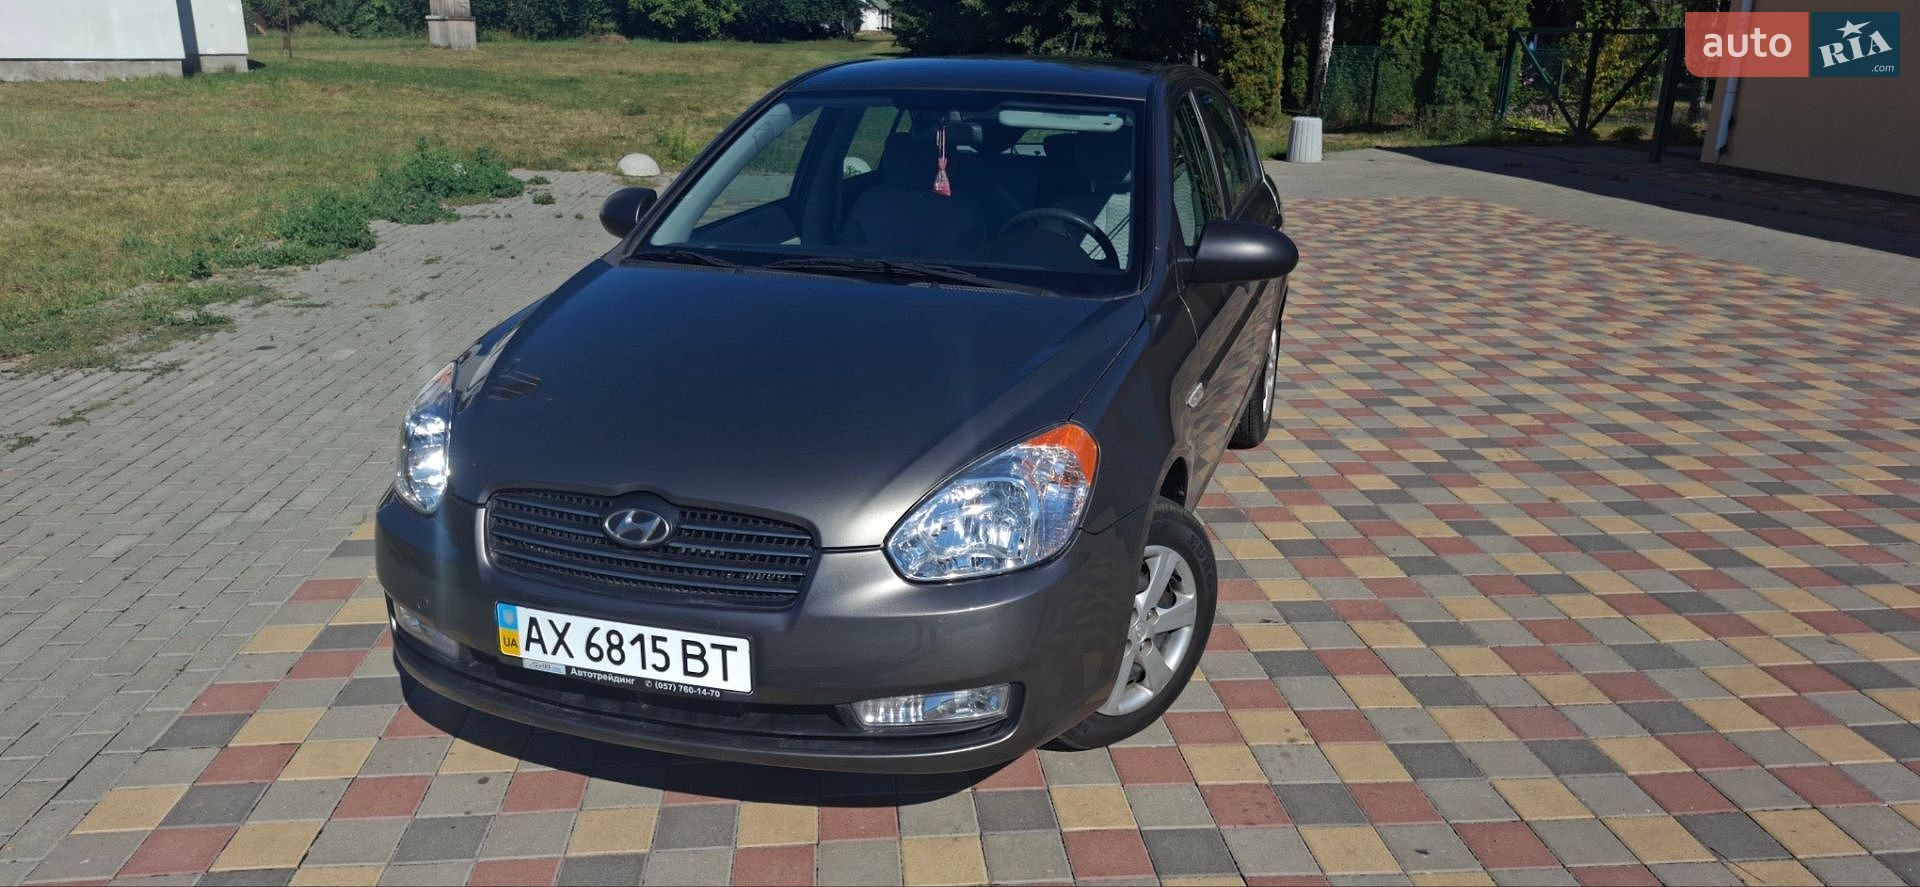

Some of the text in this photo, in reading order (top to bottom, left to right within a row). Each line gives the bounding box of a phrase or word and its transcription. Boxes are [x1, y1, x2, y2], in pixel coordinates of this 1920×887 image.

[503, 636, 518, 648] UA
[525, 616, 738, 682] AX 6815 BT
[570, 667, 720, 698] Автотрейдинг (057) 760-14-70
